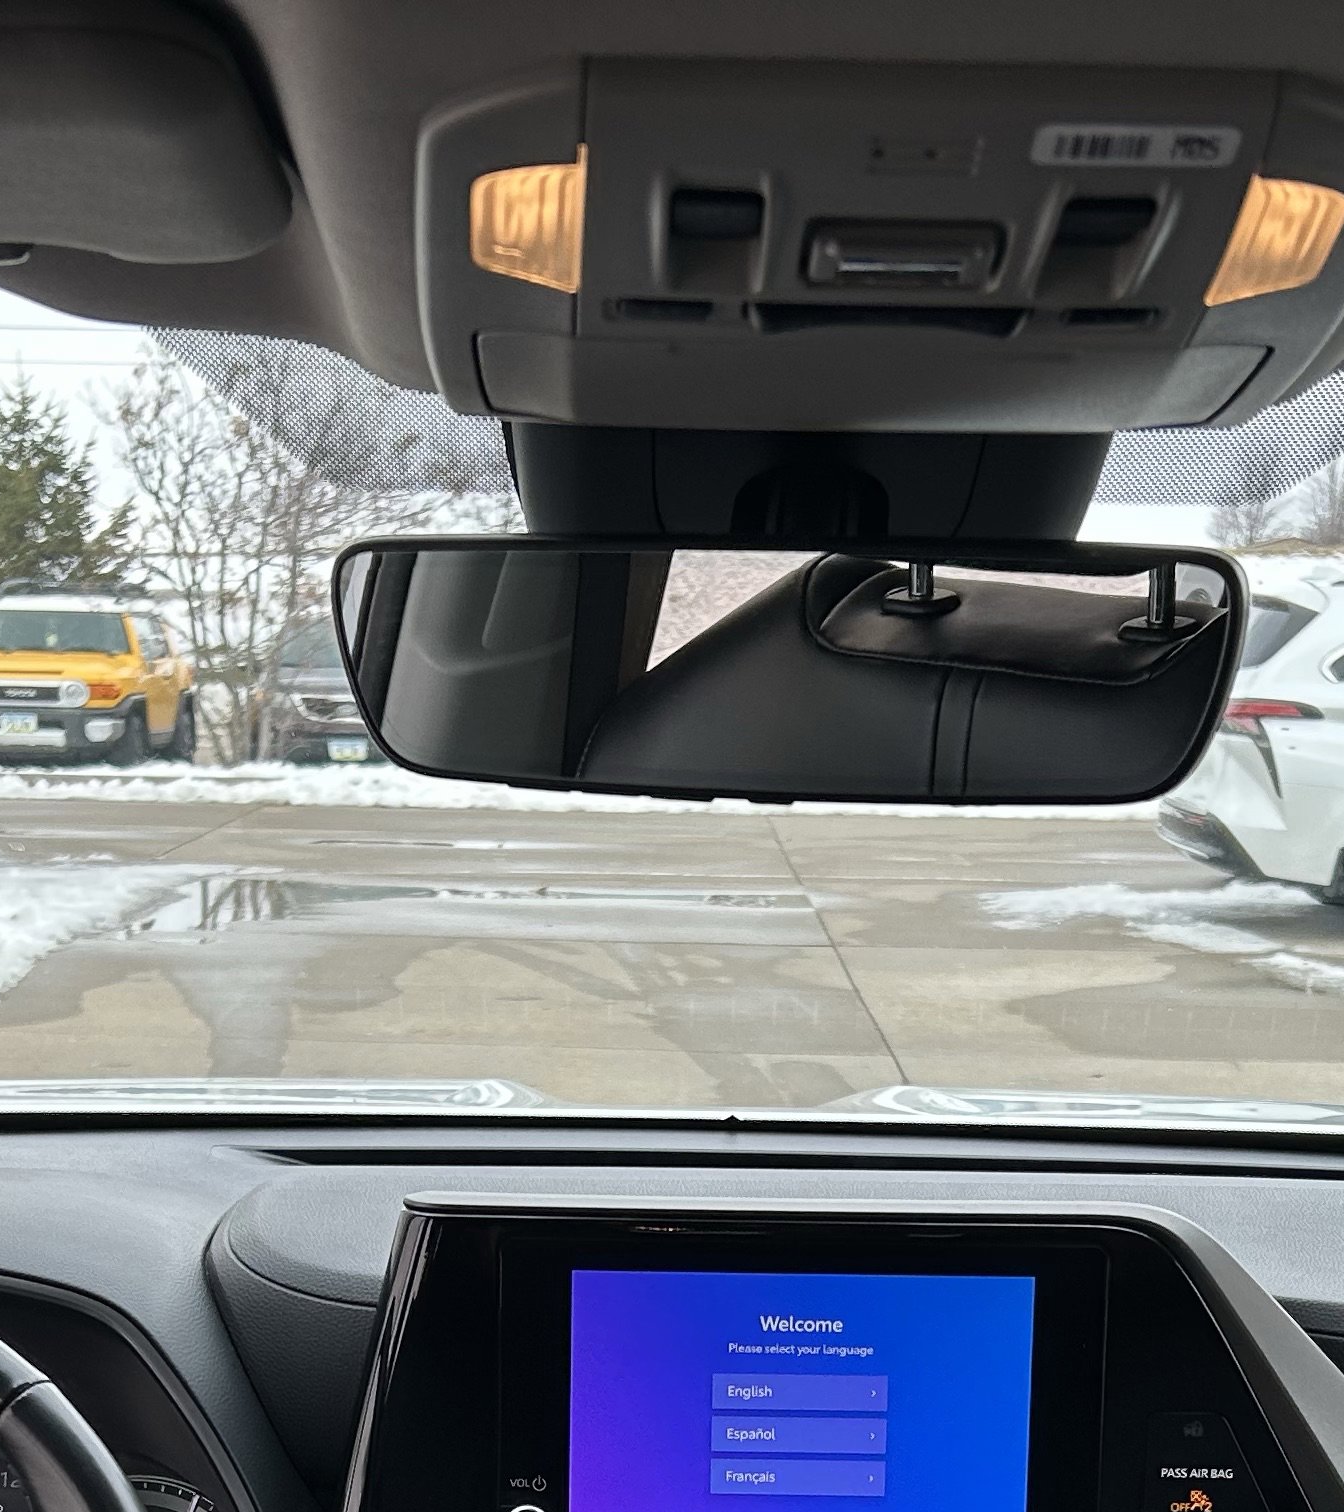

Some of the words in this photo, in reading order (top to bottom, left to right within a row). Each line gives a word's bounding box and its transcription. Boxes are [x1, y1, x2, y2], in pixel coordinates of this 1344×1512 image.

[759, 1315, 844, 1333] Welcome
[728, 1343, 763, 1354] Please
[764, 1343, 795, 1355] select
[796, 1346, 821, 1357] your
[822, 1344, 874, 1358] language
[727, 1385, 773, 1400] English
[726, 1427, 776, 1442] Español
[725, 1470, 776, 1485] Français
[1160, 1467, 1188, 1478] PASS
[1189, 1468, 1209, 1479] AIR
[1210, 1468, 1234, 1479] BAG
[509, 1478, 531, 1488] VOL
[1170, 1502, 1191, 1512] OFF
